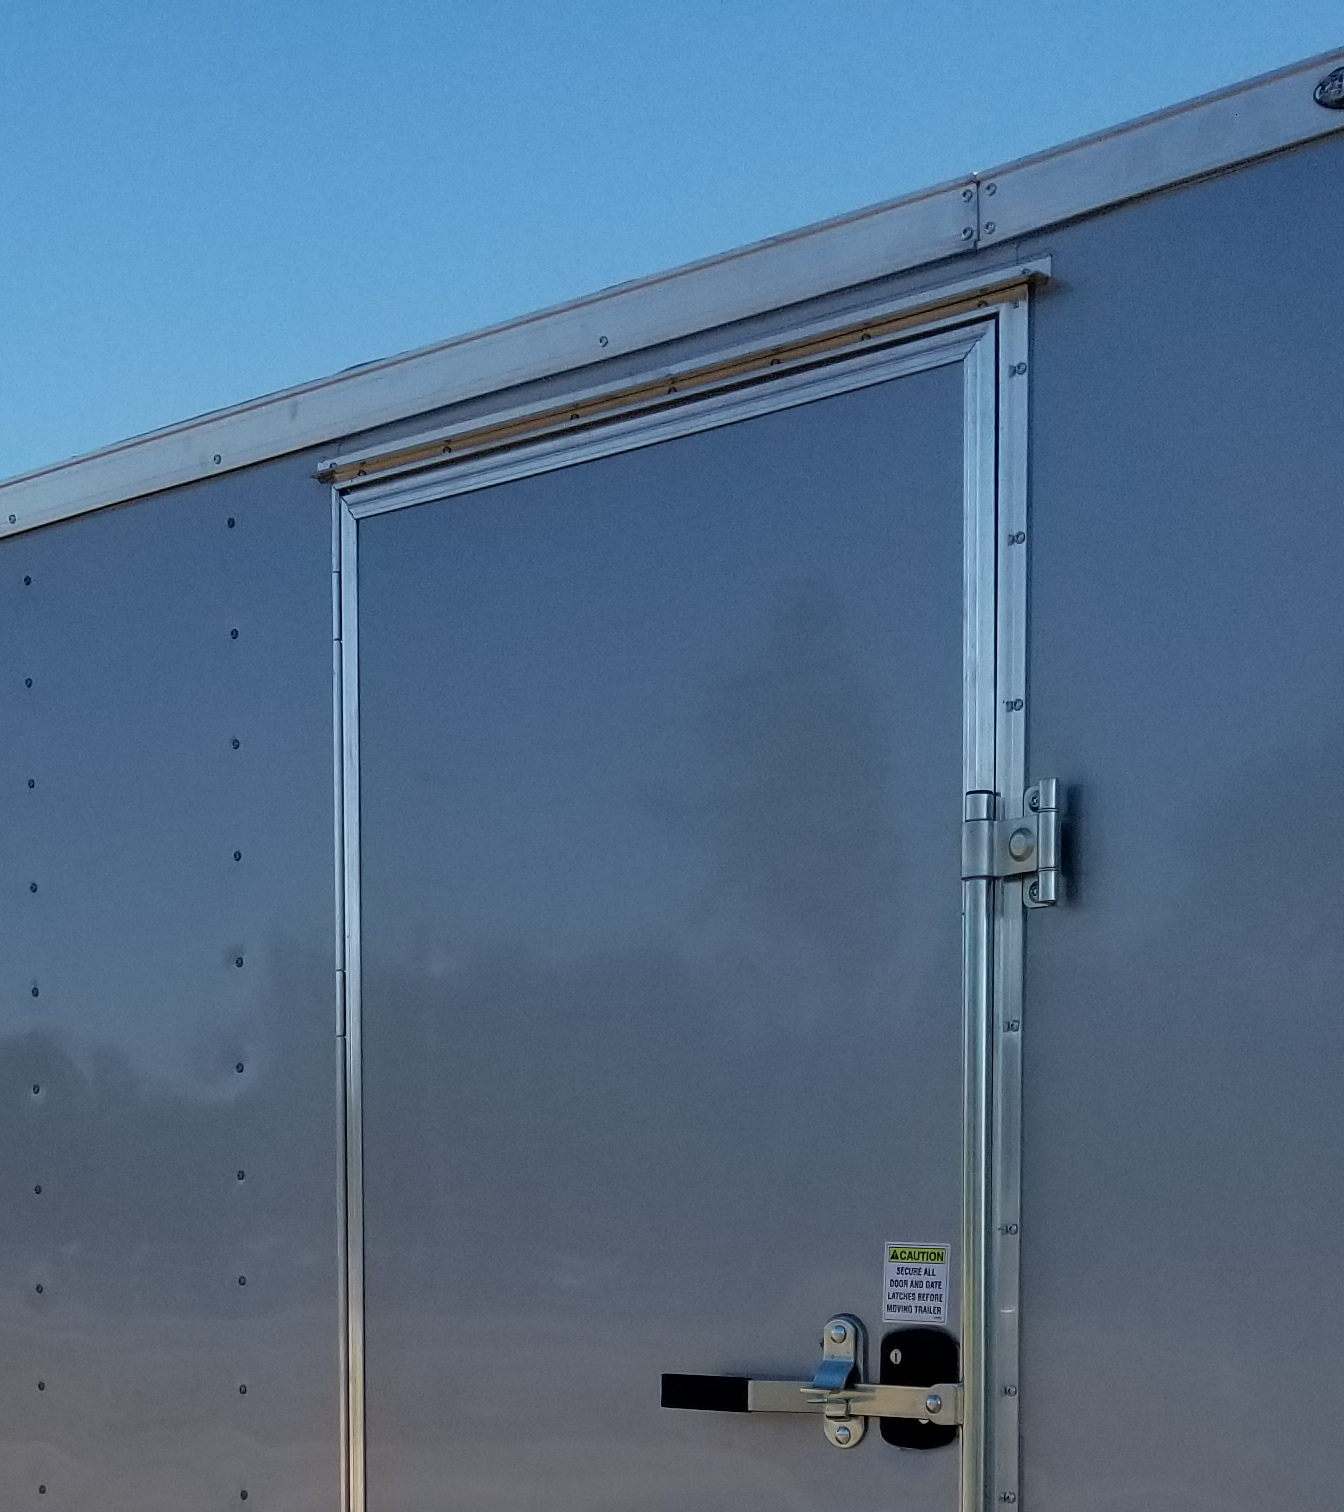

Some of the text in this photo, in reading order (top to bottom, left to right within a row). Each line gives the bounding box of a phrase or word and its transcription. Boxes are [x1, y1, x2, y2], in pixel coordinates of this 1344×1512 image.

[899, 1250, 944, 1262] CAUTION
[896, 1266, 937, 1277] SECURE ALL
[889, 1279, 942, 1290] DOOR AND GATE
[887, 1291, 944, 1303] LATCHES BEFORE
[886, 1304, 942, 1315] MOVING TRAILER
